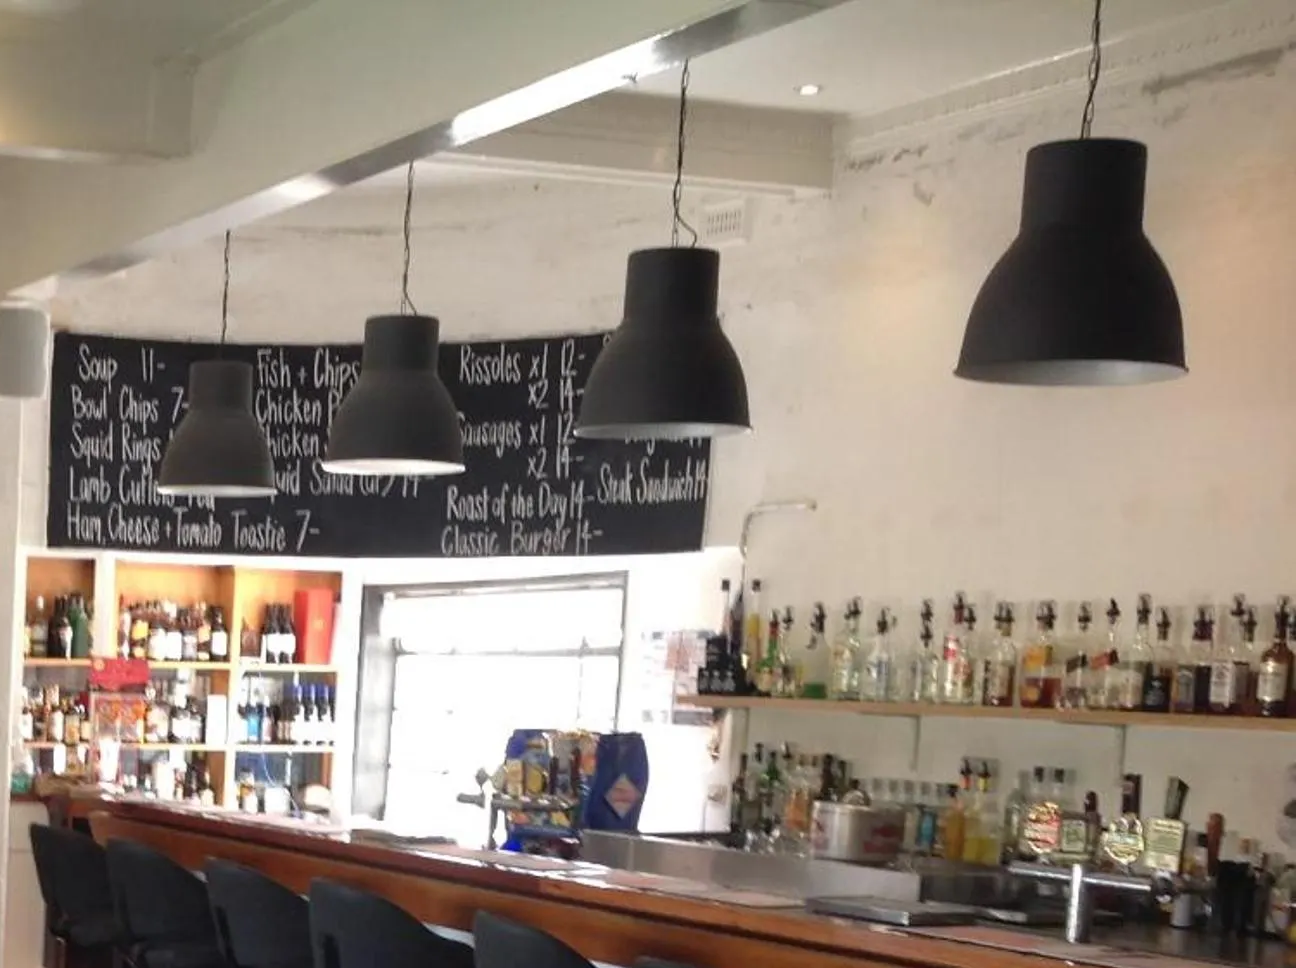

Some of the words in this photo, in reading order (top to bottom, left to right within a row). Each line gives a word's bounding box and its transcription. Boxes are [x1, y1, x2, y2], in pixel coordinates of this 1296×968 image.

[78, 343, 118, 394] Soup
[257, 348, 291, 388] Fish
[313, 347, 360, 400] Chips
[459, 343, 521, 385] Rissoles
[70, 384, 108, 419] Bowl
[119, 384, 159, 436] Chips
[255, 388, 322, 426] Chicken
[70, 420, 113, 468] Squid
[122, 421, 162, 470] Rings
[258, 423, 320, 457] hicken
[69, 464, 112, 504] Lamb
[597, 463, 633, 504] Steak
[636, 457, 693, 503] Sandwich
[108, 502, 161, 547] Cheese
[173, 506, 223, 548] Tomato
[231, 509, 287, 552] Toastie
[447, 484, 489, 522] Roast
[492, 482, 509, 524] of
[512, 484, 534, 519] the
[538, 480, 568, 532] Day
[441, 523, 501, 556] Classic
[511, 517, 571, 555] Burger
